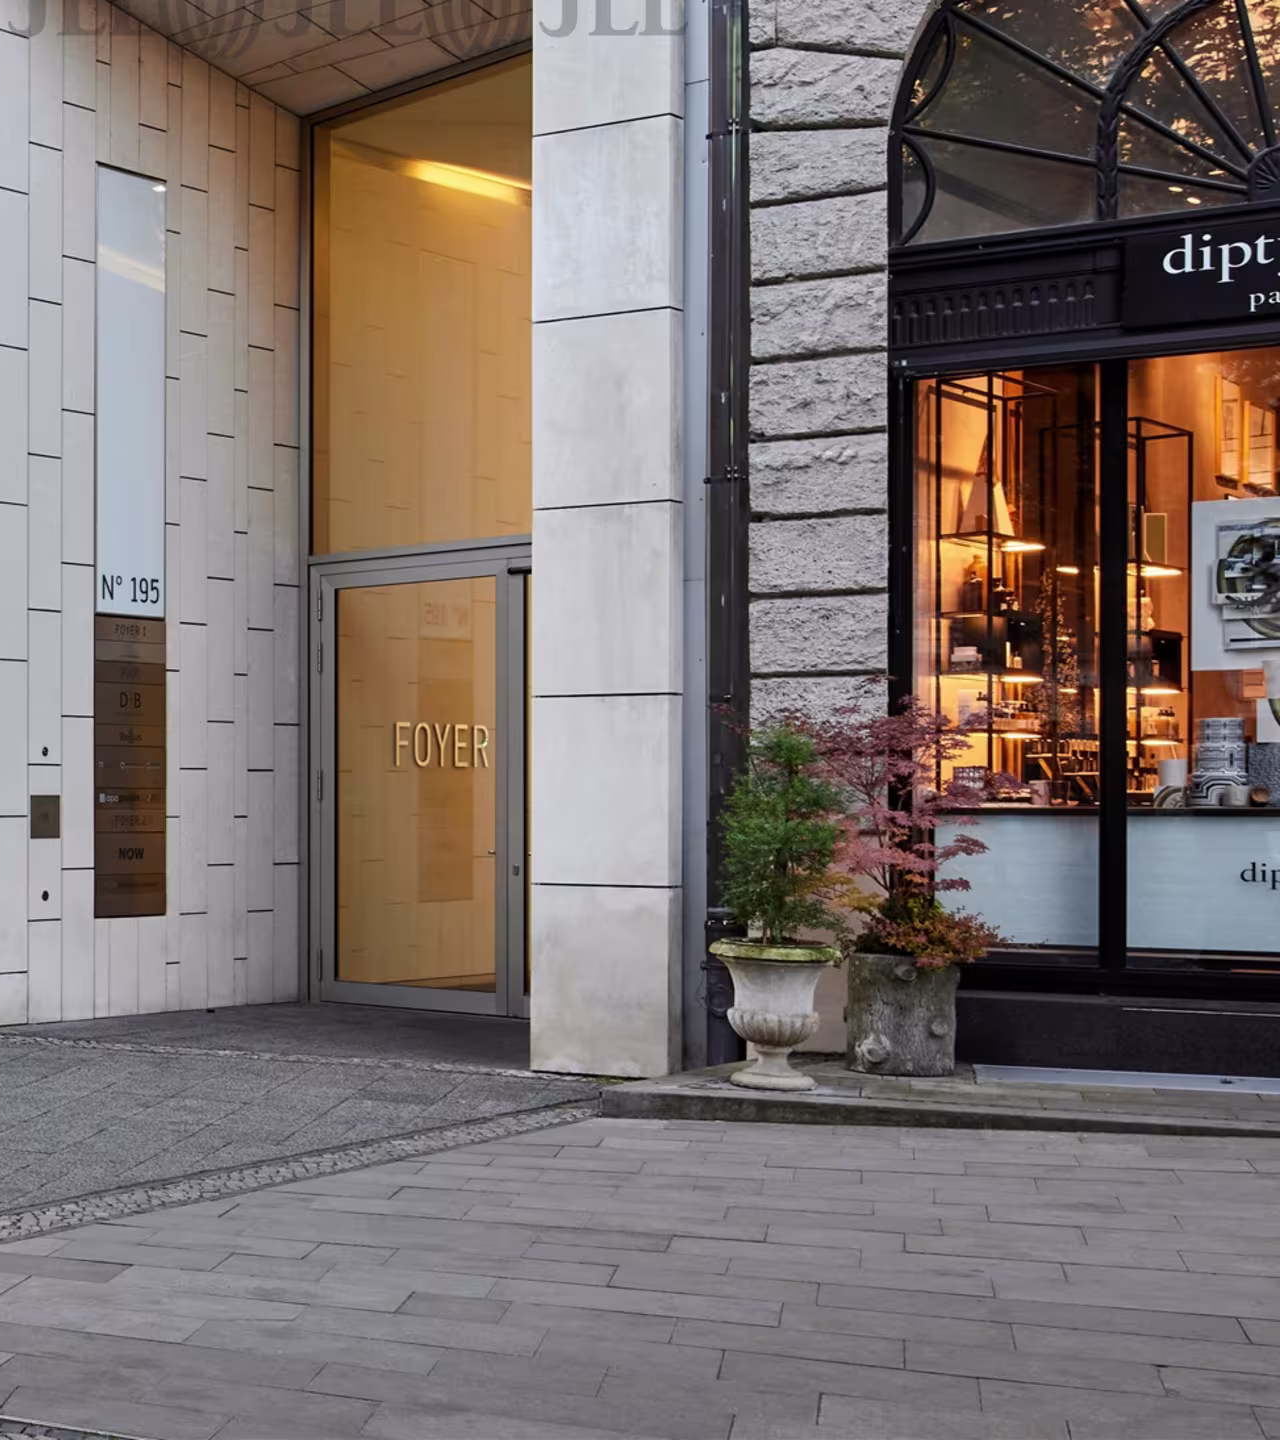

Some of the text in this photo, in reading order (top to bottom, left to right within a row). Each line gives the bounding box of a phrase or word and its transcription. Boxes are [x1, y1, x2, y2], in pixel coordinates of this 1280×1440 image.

[1162, 233, 1280, 283] dipt
[102, 574, 160, 605] N° 195
[395, 721, 490, 768] FOYER
[118, 847, 144, 861] NOW
